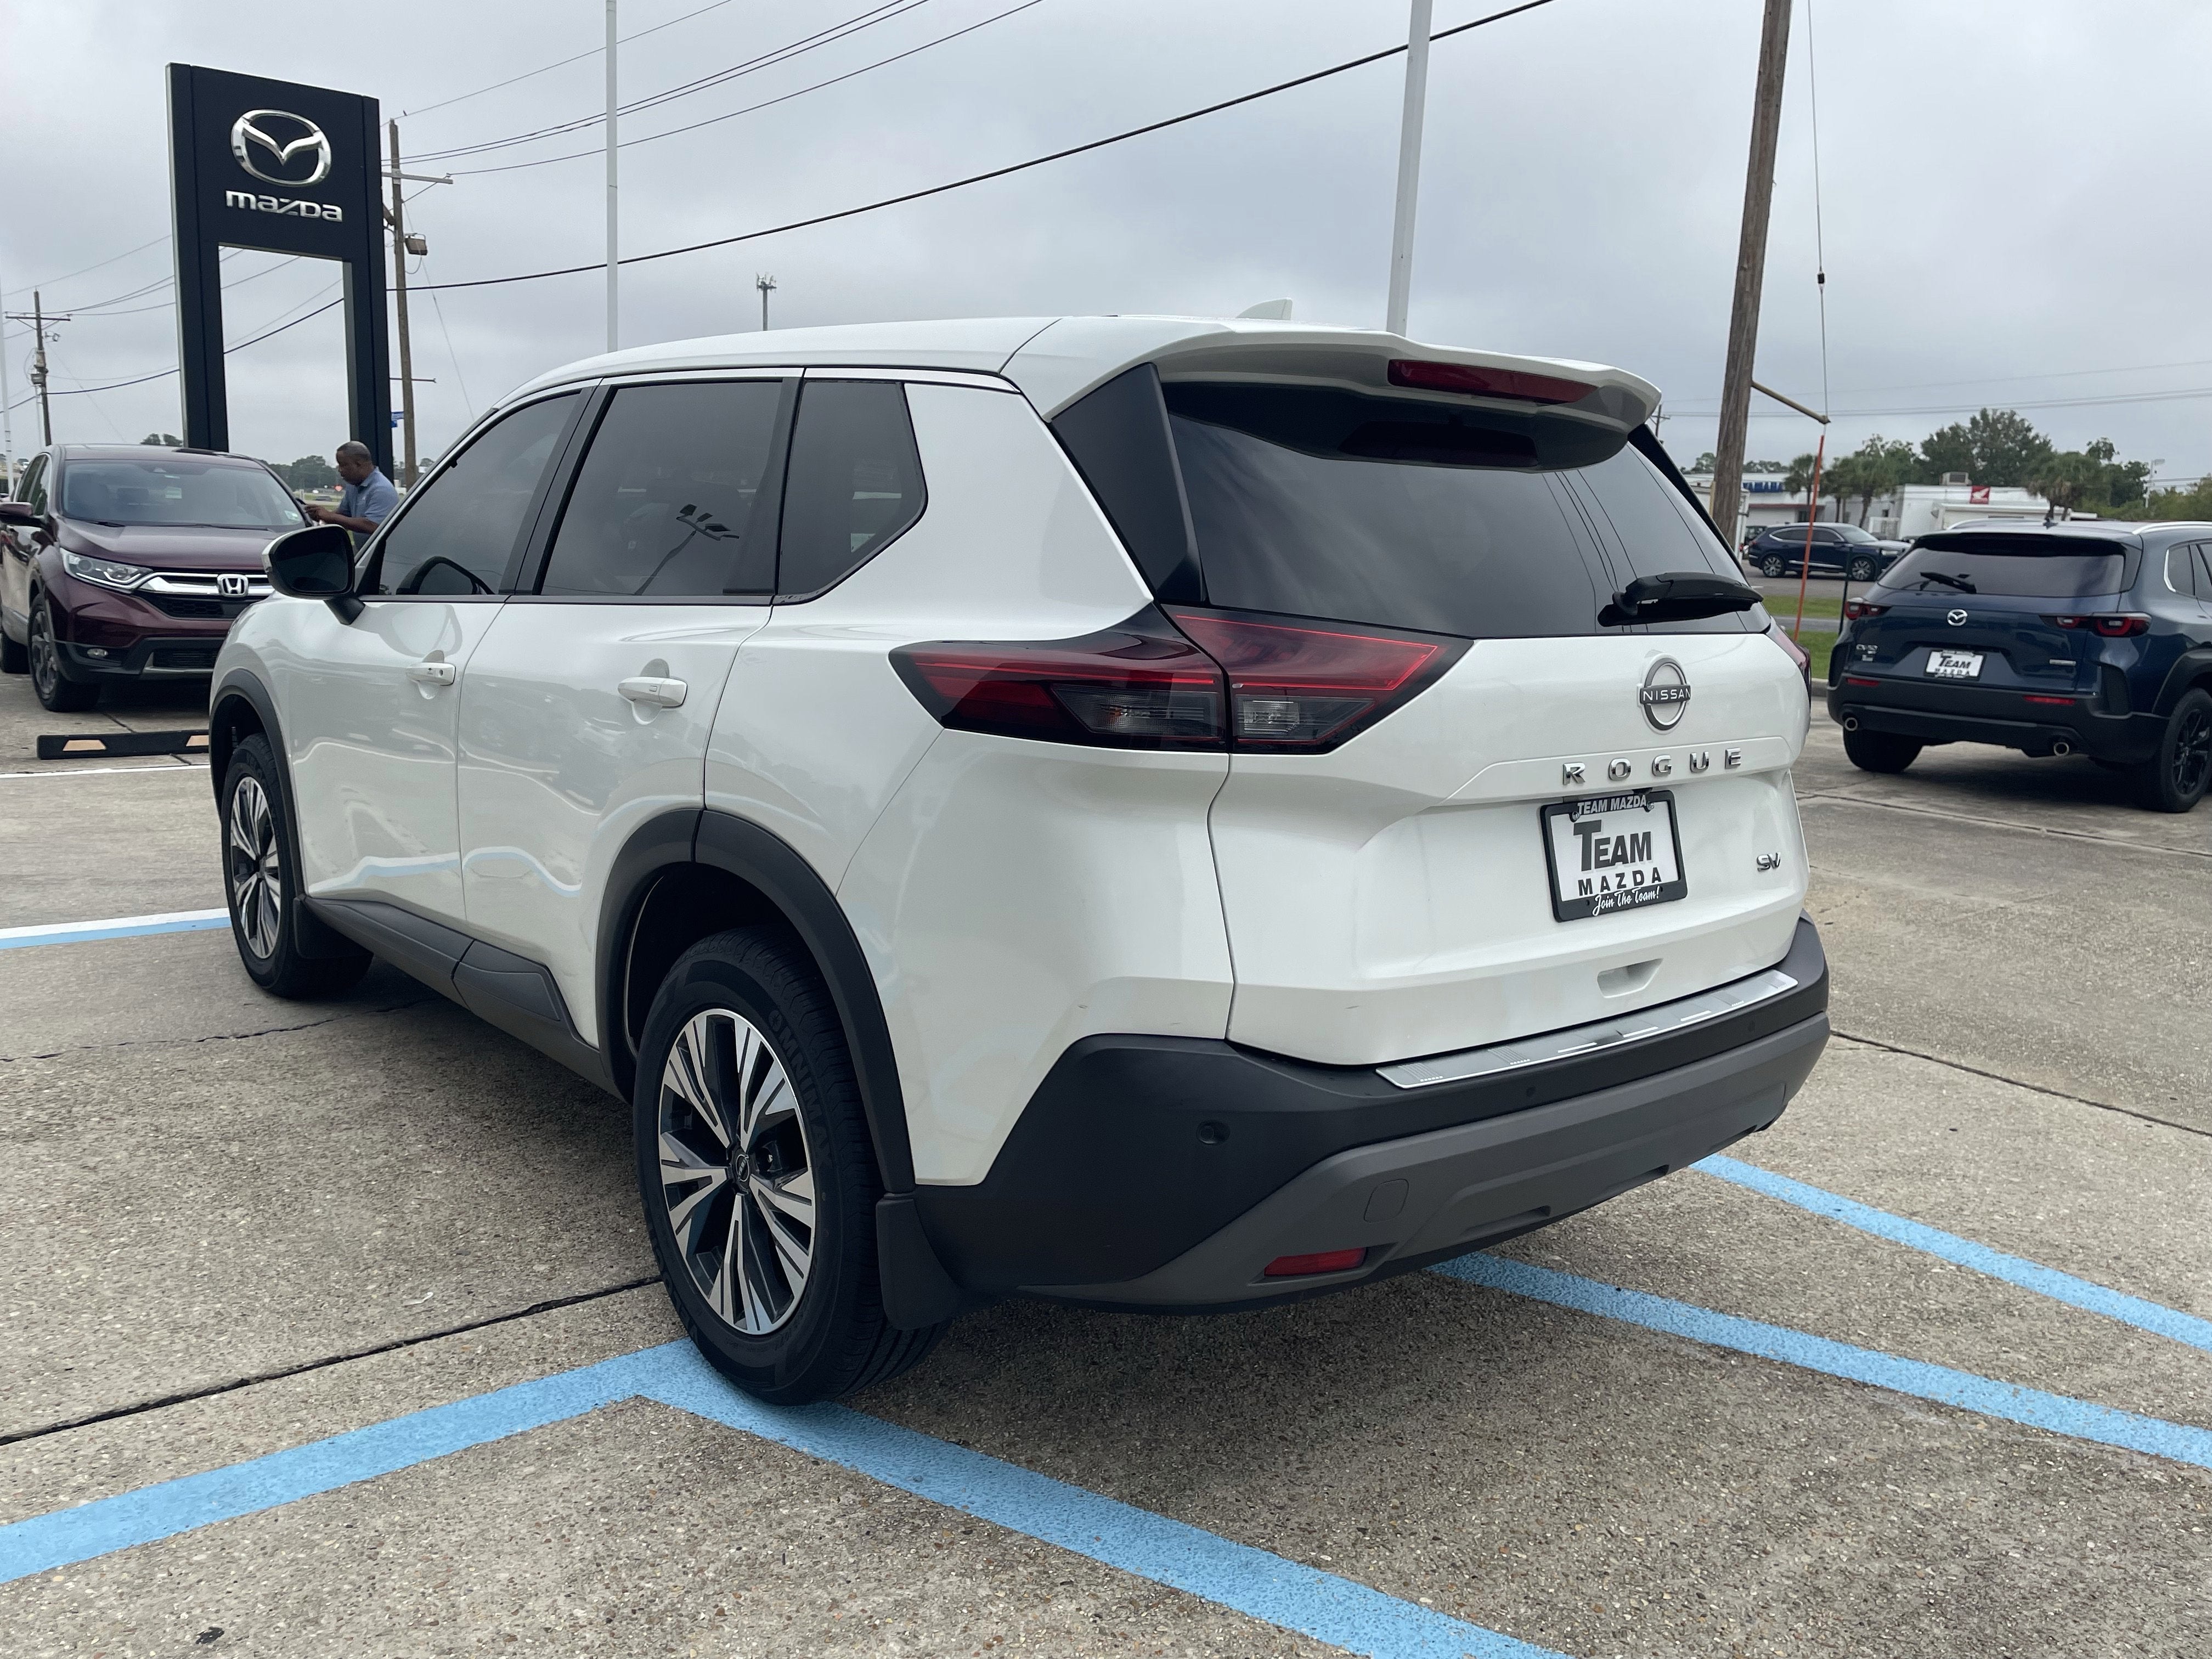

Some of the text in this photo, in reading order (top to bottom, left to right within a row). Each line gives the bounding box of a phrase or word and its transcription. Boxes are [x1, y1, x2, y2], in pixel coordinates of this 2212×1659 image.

[1643, 687, 1690, 702] NISSAN
[1562, 748, 1742, 785] ROGUE
[1577, 794, 1647, 815] TEAM MAZDA
[1573, 819, 1652, 872] TEAM
[1756, 852, 1782, 872] SV
[1578, 867, 1662, 896] MAZDA
[1592, 885, 1660, 917] Join The Team!
